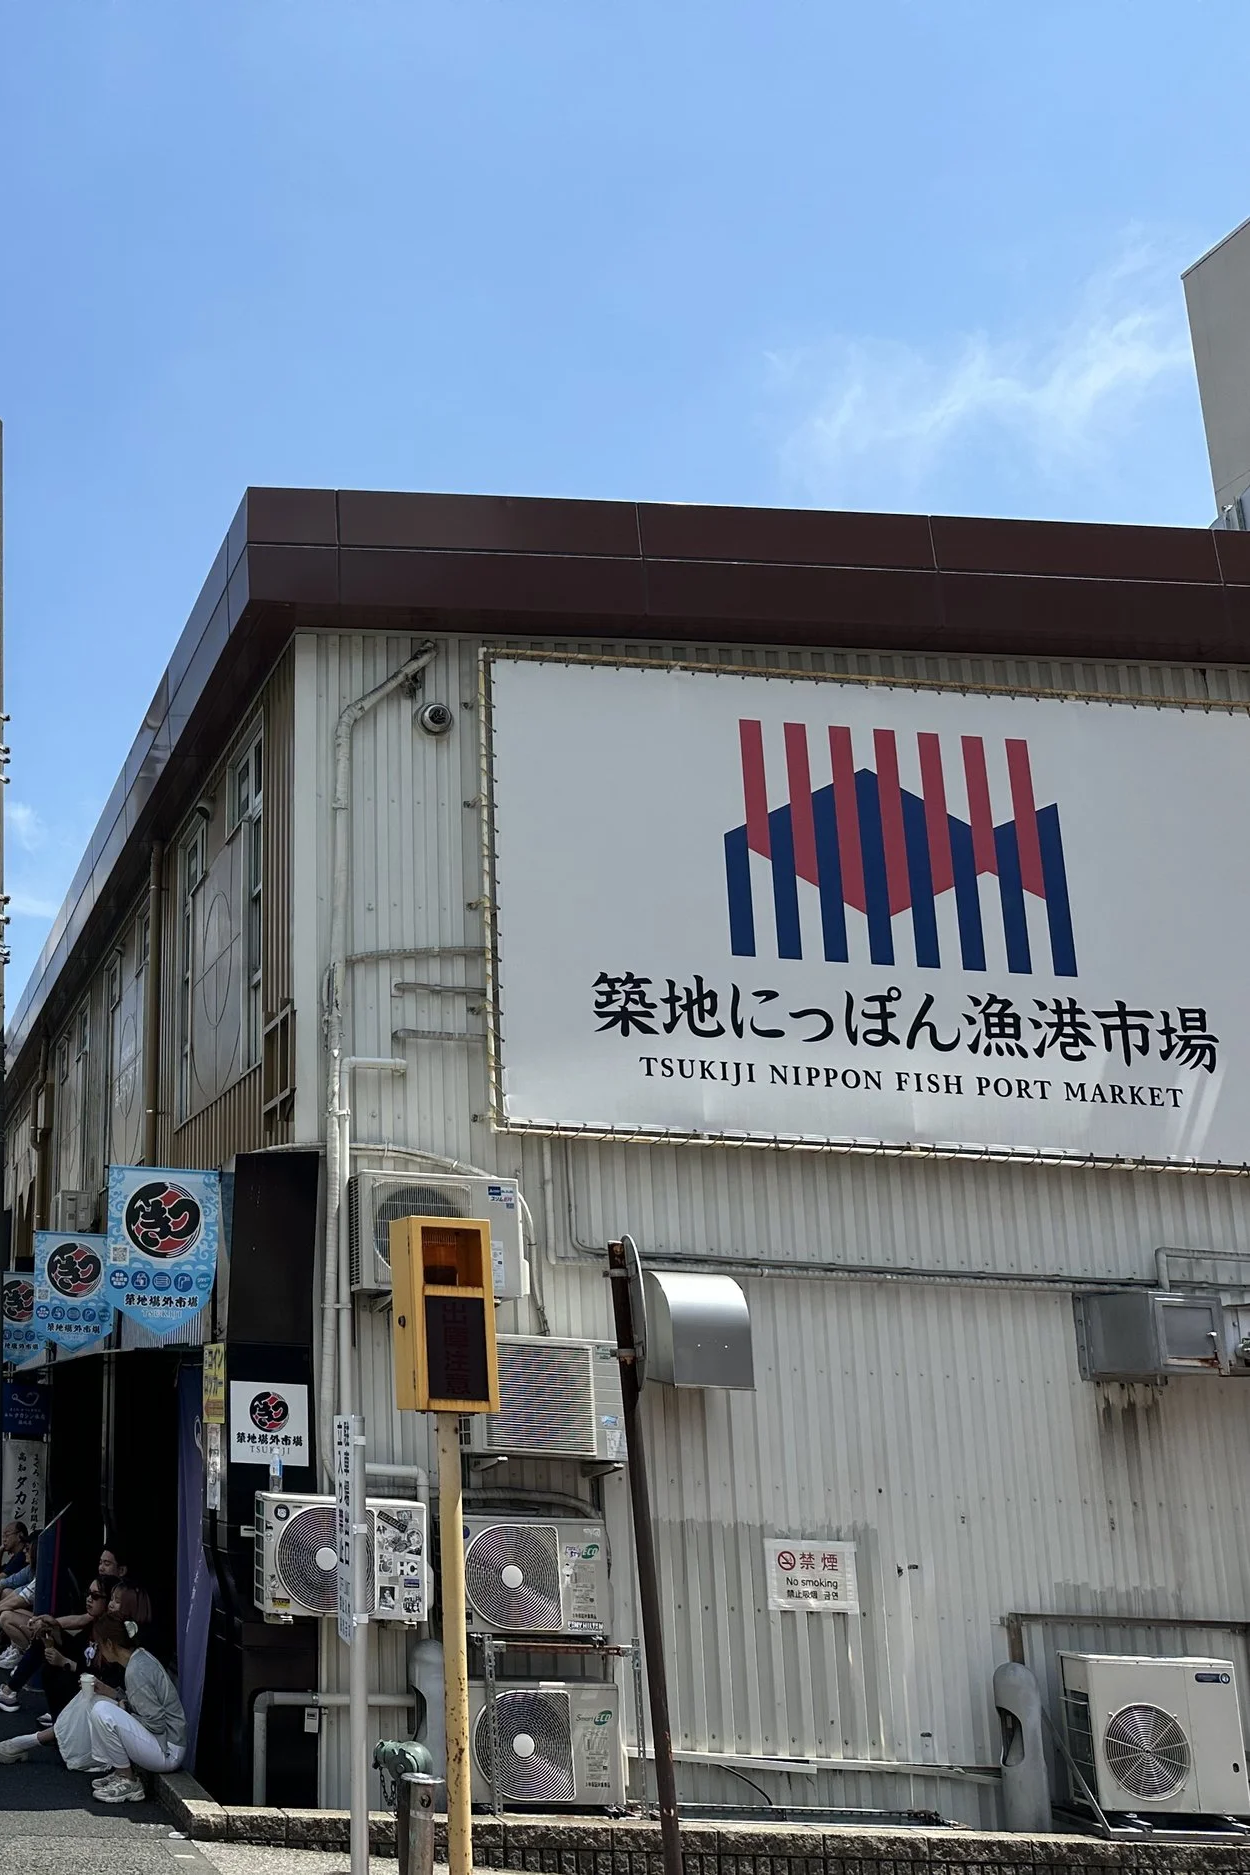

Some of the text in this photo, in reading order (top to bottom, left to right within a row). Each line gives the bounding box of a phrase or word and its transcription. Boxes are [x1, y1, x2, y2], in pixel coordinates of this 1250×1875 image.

[592, 971, 1219, 1074] 築地にっぽん漁港市場
[638, 1056, 1184, 1108] TSUKIJI NIPPON FISH PORT MARKET
[124, 1293, 198, 1308] 築地場外市場
[236, 1432, 303, 1447] 築地場外市場
[583, 1546, 598, 1556] ECO
[799, 1552, 838, 1571] 禁煙
[397, 1562, 418, 1576] HC
[786, 1577, 838, 1590] No smoking
[823, 1591, 838, 1600] 금연
[576, 1713, 611, 1722] Smart ECO
